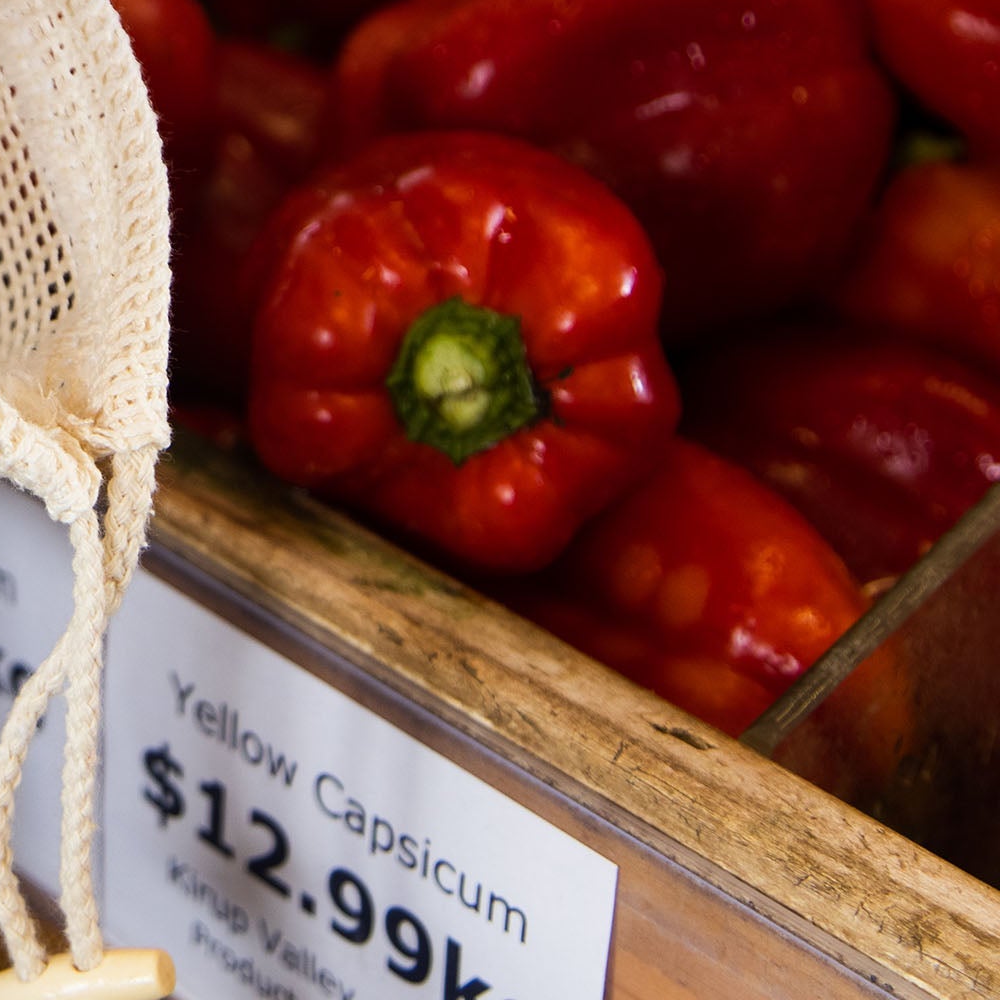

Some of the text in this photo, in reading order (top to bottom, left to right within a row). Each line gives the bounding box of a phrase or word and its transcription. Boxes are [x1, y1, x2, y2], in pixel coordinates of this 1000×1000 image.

[142, 740, 514, 1000] $12.99k
[169, 670, 527, 943] Yellow Capsicum
